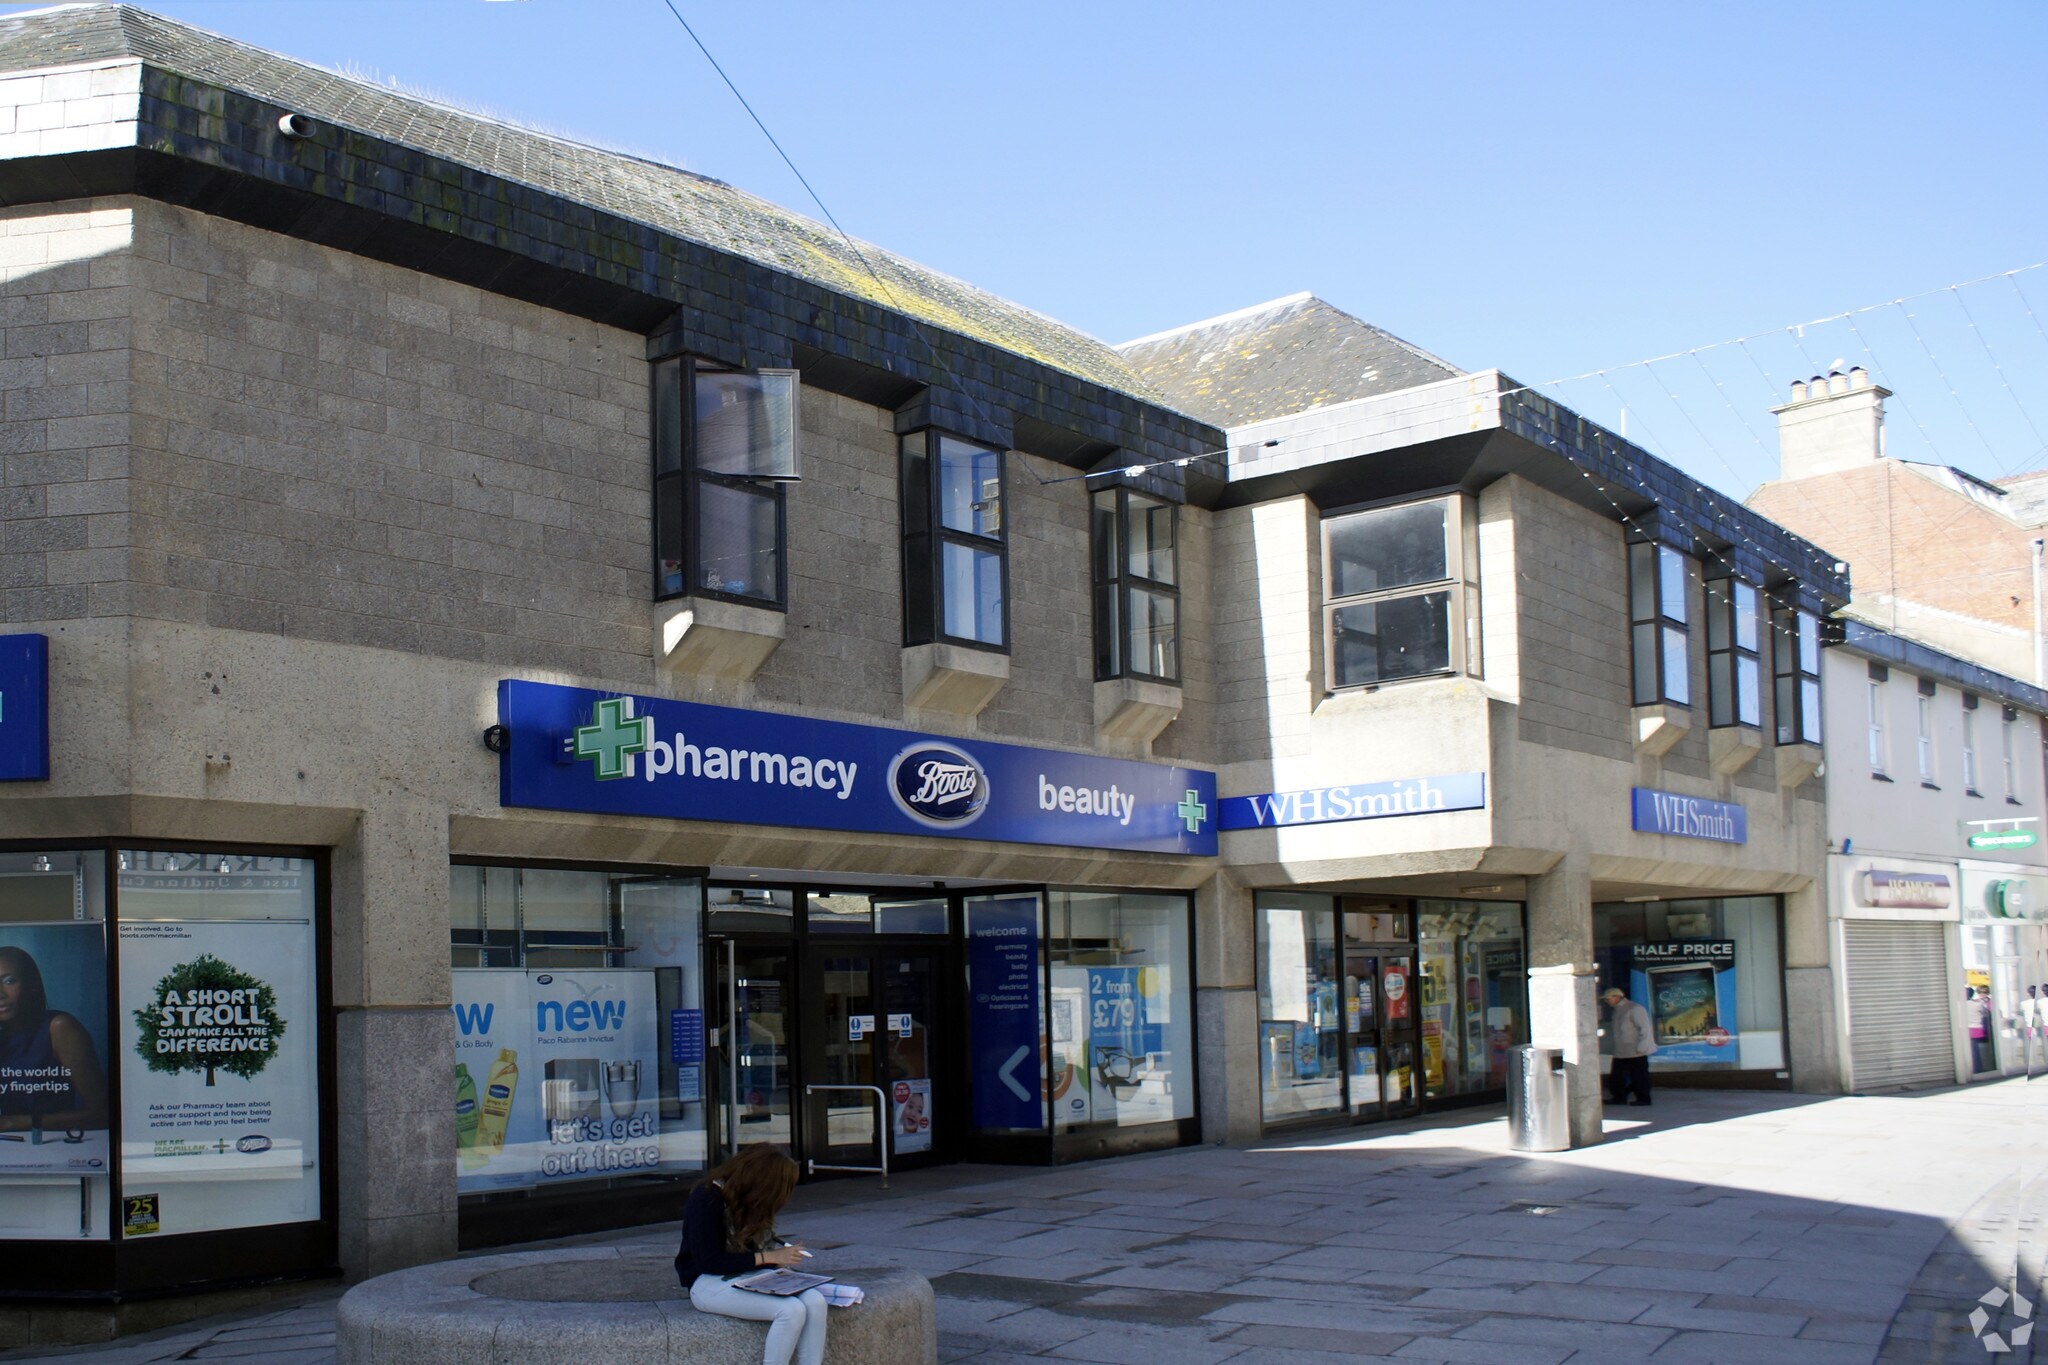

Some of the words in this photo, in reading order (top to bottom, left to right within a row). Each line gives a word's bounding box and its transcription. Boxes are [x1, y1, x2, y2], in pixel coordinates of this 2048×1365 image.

[645, 732, 857, 800] pharmacy
[909, 760, 977, 804] Boots
[1038, 774, 1135, 825] beauty
[1247, 778, 1446, 826] WHSmith
[1652, 793, 1735, 840] WHSmith
[976, 927, 1028, 937] welcome
[1633, 944, 1678, 955] HALF
[1683, 943, 1733, 955] PRICE
[1092, 974, 1102, 994] 2
[1106, 980, 1132, 994] from
[165, 990, 182, 1005] A
[186, 988, 259, 1005] SHORT
[160, 1004, 267, 1027] STROLL
[537, 1000, 626, 1033] new
[1092, 998, 1135, 1028] £79
[158, 1028, 185, 1037] CAN
[186, 1028, 221, 1037] MAKE
[222, 1028, 244, 1036] ALL
[246, 1027, 268, 1035] THE
[537, 1037, 556, 1045] Paco
[558, 1036, 587, 1044] Rabanne
[588, 1035, 614, 1043] Invictus
[156, 1037, 269, 1054] DIFFERENCE
[475, 1040, 494, 1049] Body
[1, 1066, 22, 1077] the
[24, 1066, 59, 1077] world
[61, 1066, 72, 1077] is
[10, 1081, 70, 1093] fingertips
[179, 1111, 211, 1119] support
[183, 1103, 224, 1111] Pharmacy
[194, 1119, 211, 1127] help
[550, 1115, 604, 1144] let's
[610, 1112, 654, 1145] get
[542, 1146, 588, 1177] out
[594, 1143, 661, 1172] there
[130, 1198, 153, 1216] 25
